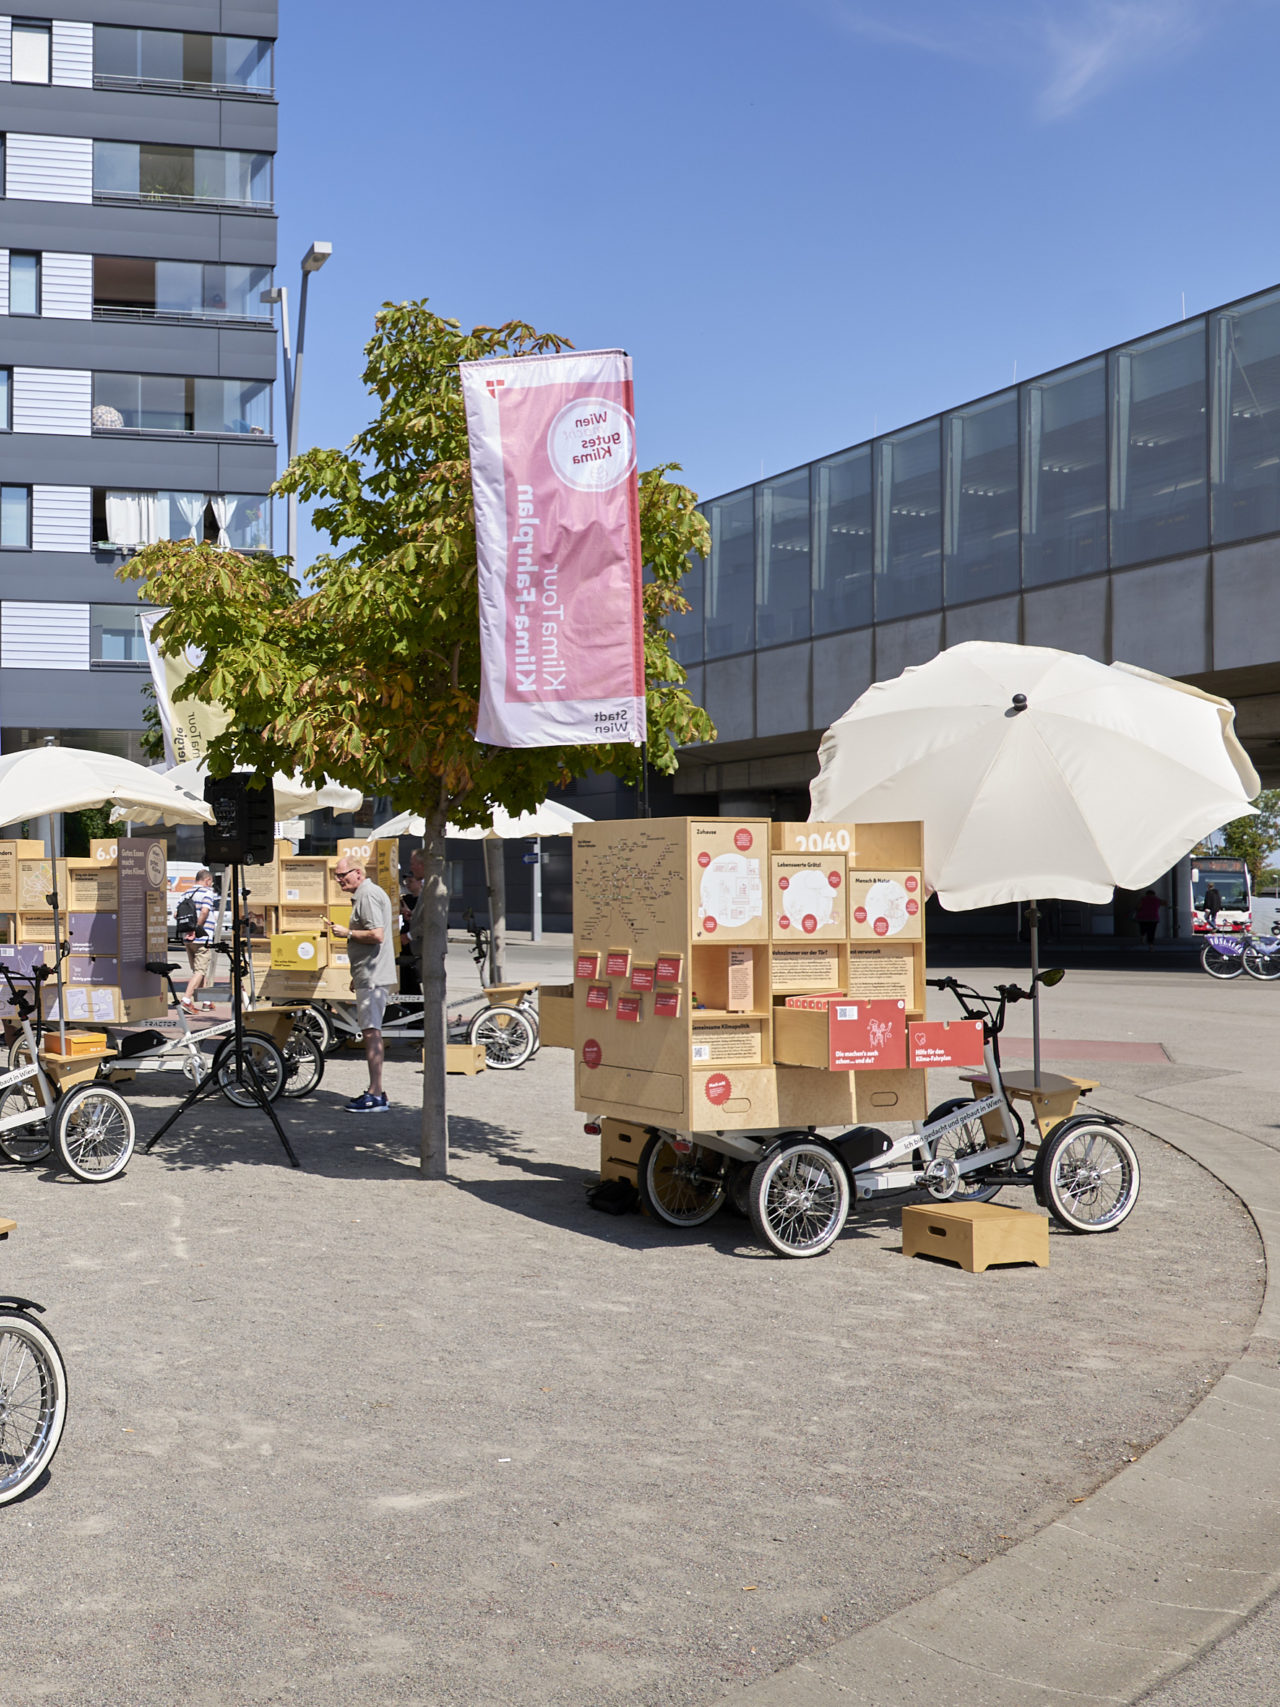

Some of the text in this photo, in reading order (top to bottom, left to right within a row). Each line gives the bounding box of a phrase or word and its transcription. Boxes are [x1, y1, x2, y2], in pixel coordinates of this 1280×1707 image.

[795, 829, 850, 851] 2040
[14, 1073, 20, 1081] in
[904, 1141, 914, 1149] Ich
[925, 1123, 948, 1140] gedacht
[948, 1119, 960, 1129] und
[960, 1109, 980, 1124] gebaut
